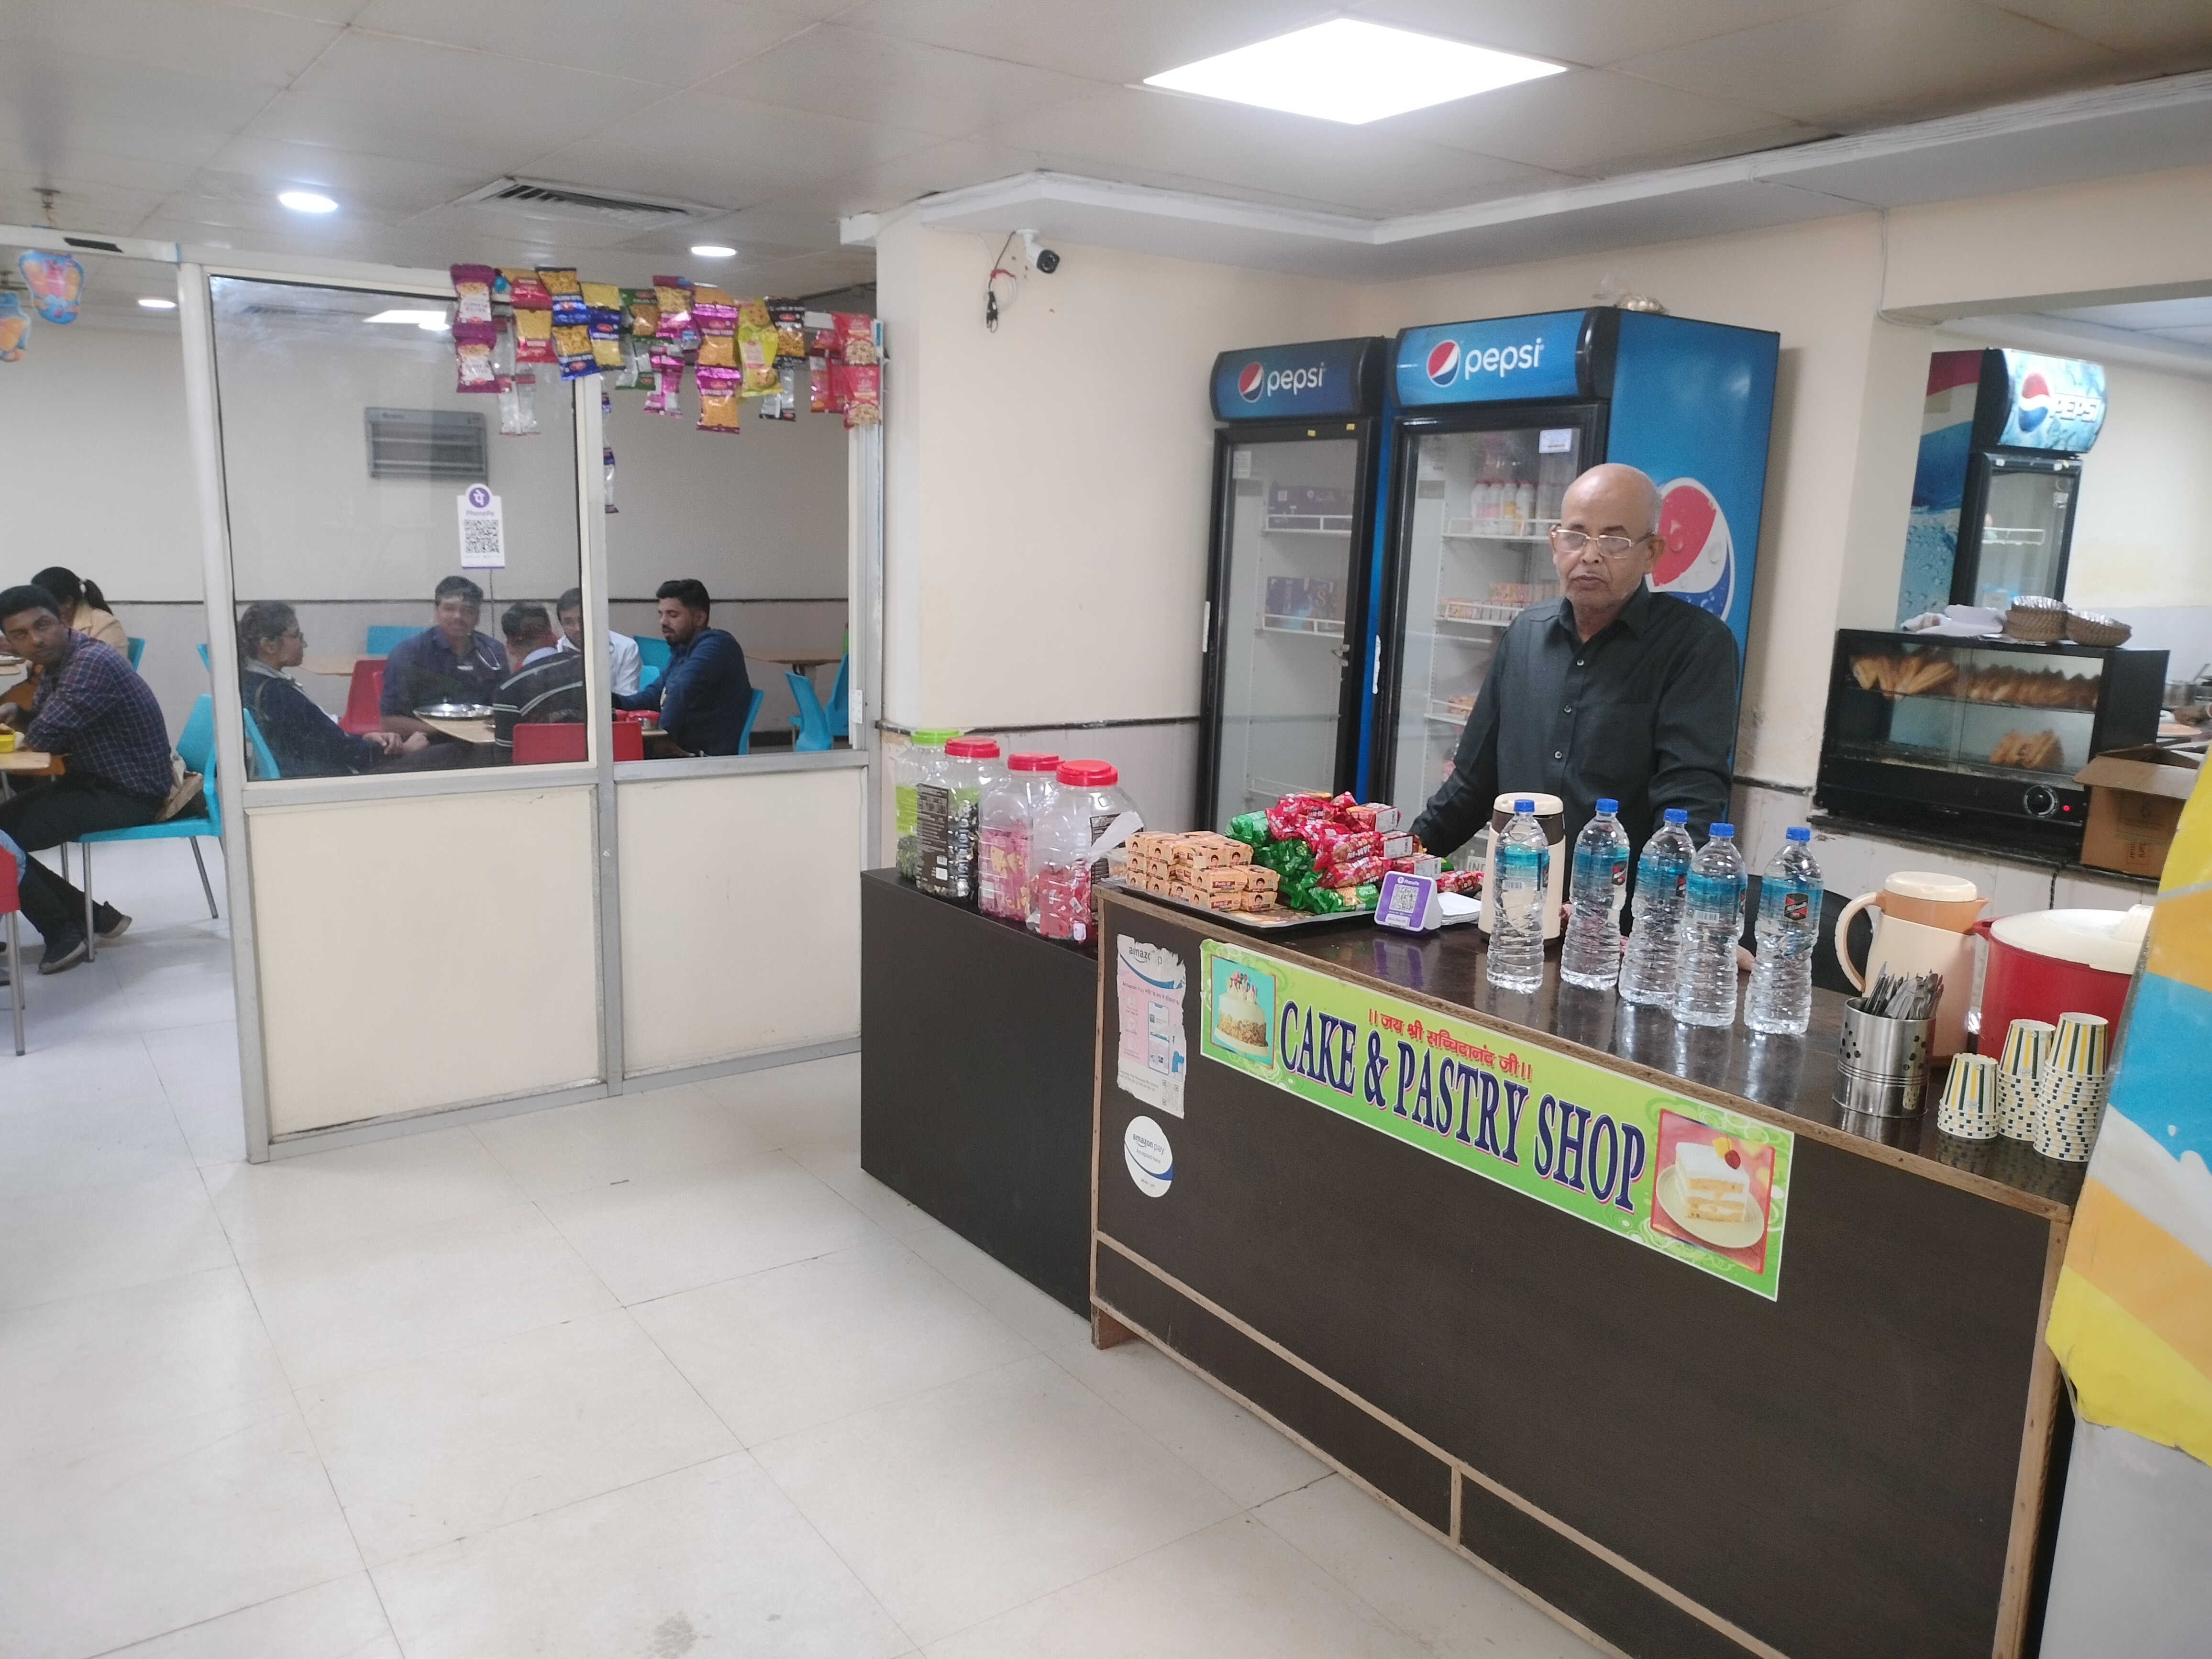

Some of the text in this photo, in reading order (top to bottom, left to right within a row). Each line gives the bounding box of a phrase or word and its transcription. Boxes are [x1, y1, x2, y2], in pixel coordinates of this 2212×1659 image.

[1465, 337, 1542, 381] pepsi
[1267, 362, 1325, 397] pepsi
[2050, 396, 2099, 423] PEPSI
[1380, 1013, 1404, 1034] जय
[1407, 1020, 1423, 1040] श्री
[1280, 1000, 1646, 1216] CAKE & PASTRY SHOP
[1133, 1133, 1164, 1155] amazon pay
[1136, 1148, 1152, 1160] Accepted
